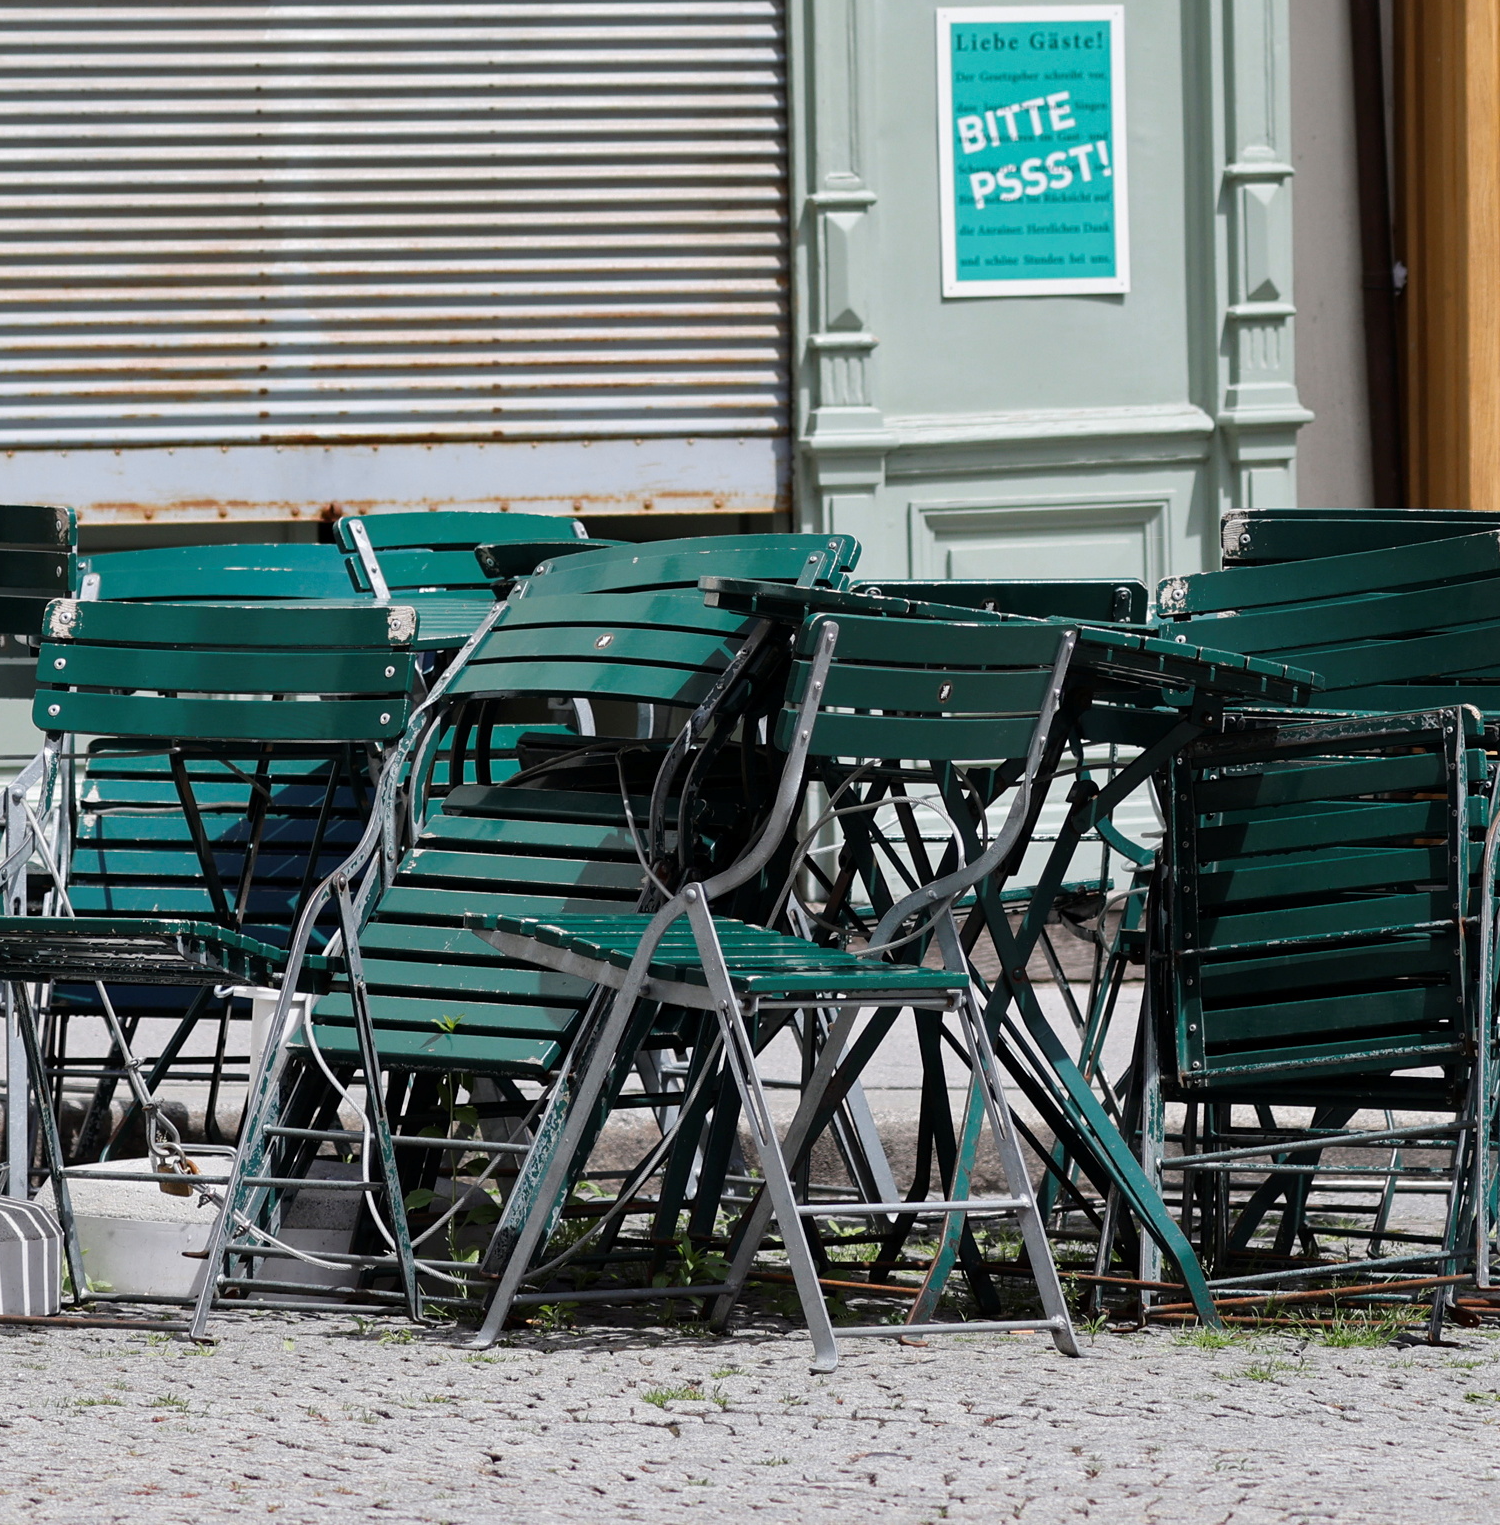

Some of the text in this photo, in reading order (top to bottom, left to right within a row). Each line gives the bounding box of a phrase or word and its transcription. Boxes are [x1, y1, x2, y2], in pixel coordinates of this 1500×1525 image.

[955, 31, 1104, 52] Liebe Gäste!
[957, 90, 1076, 154] BITTE
[969, 140, 1112, 210] PSSST!
